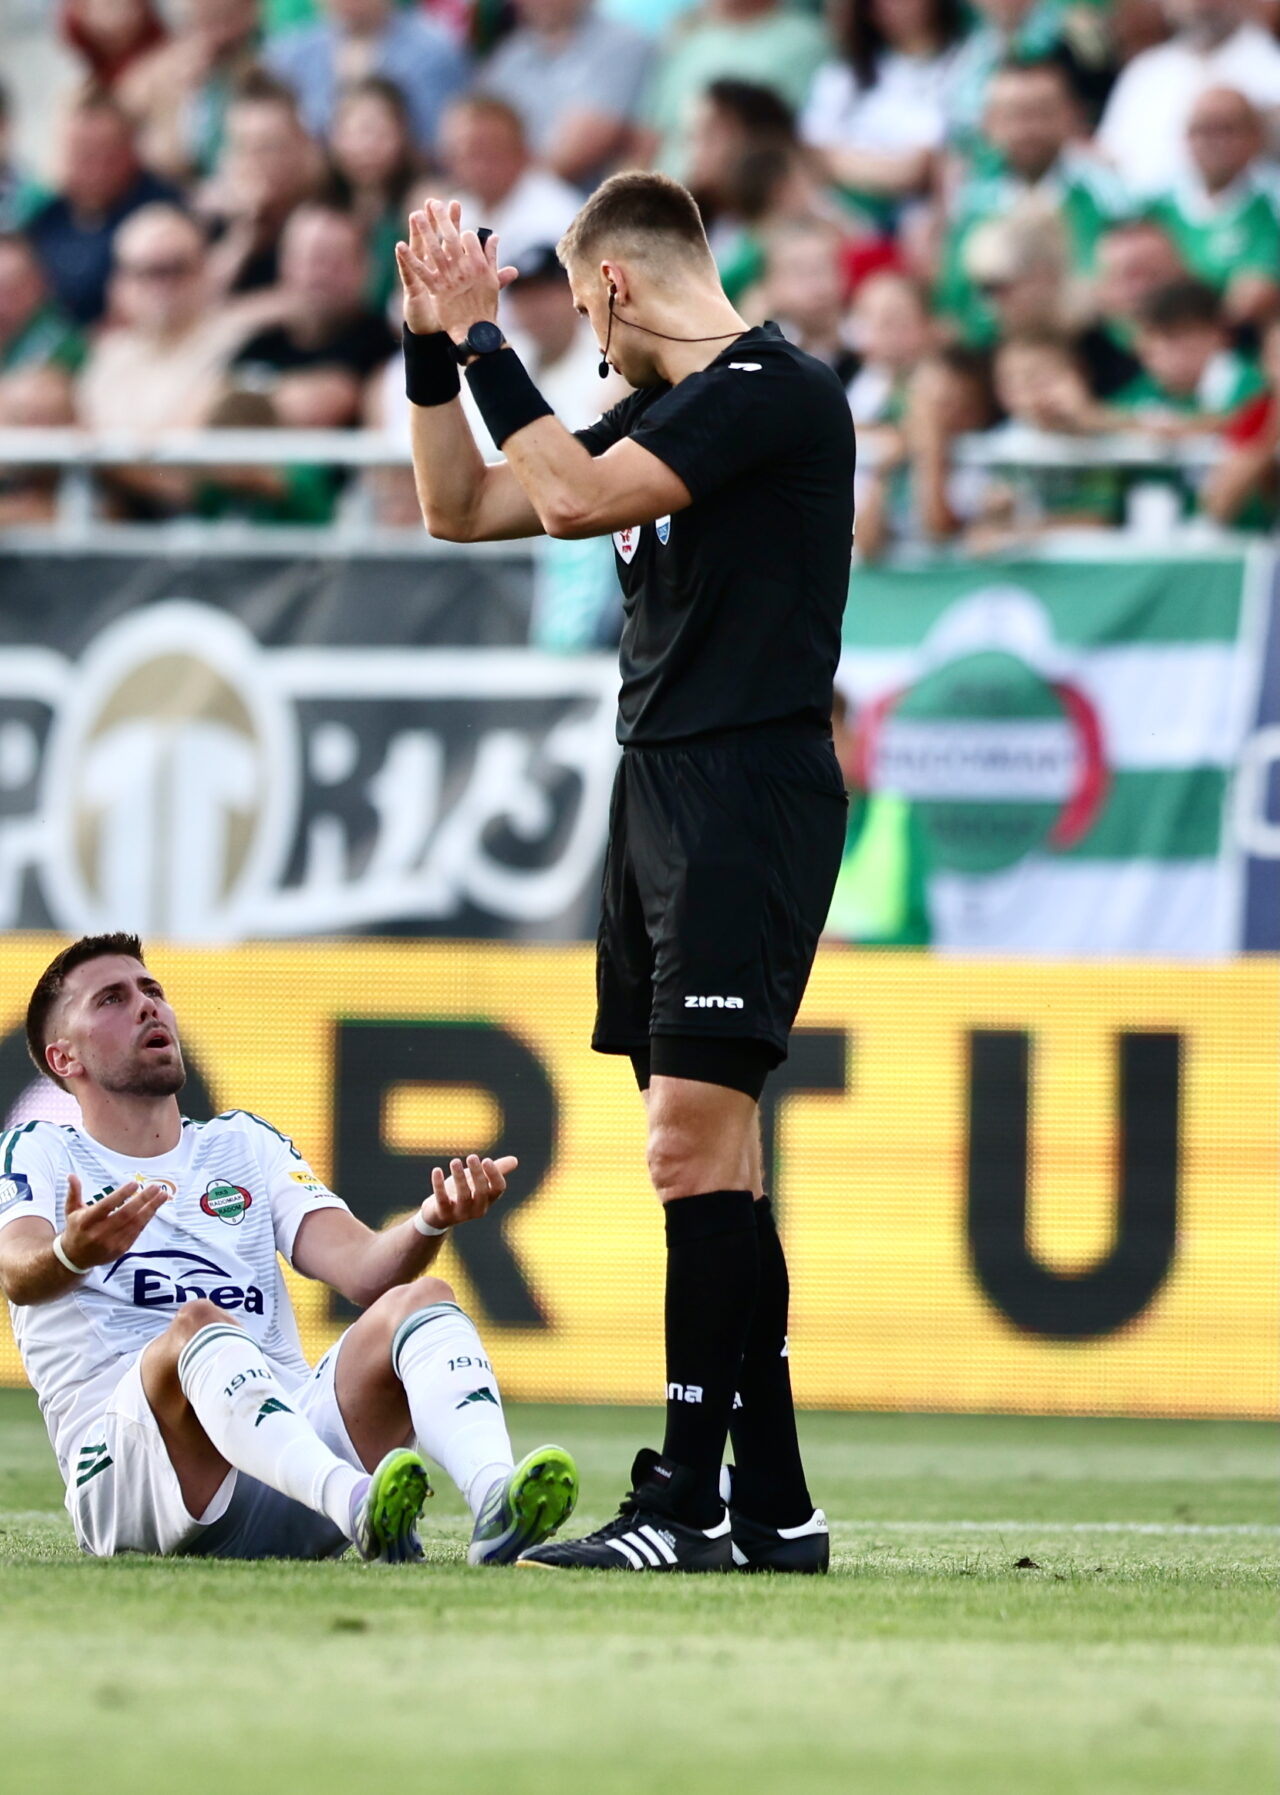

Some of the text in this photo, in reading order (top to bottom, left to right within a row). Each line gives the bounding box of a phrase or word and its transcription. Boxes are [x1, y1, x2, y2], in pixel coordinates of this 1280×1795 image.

[684, 995, 744, 1010] zina
[133, 1268, 264, 1315] Enea
[223, 1368, 272, 1397] 1910
